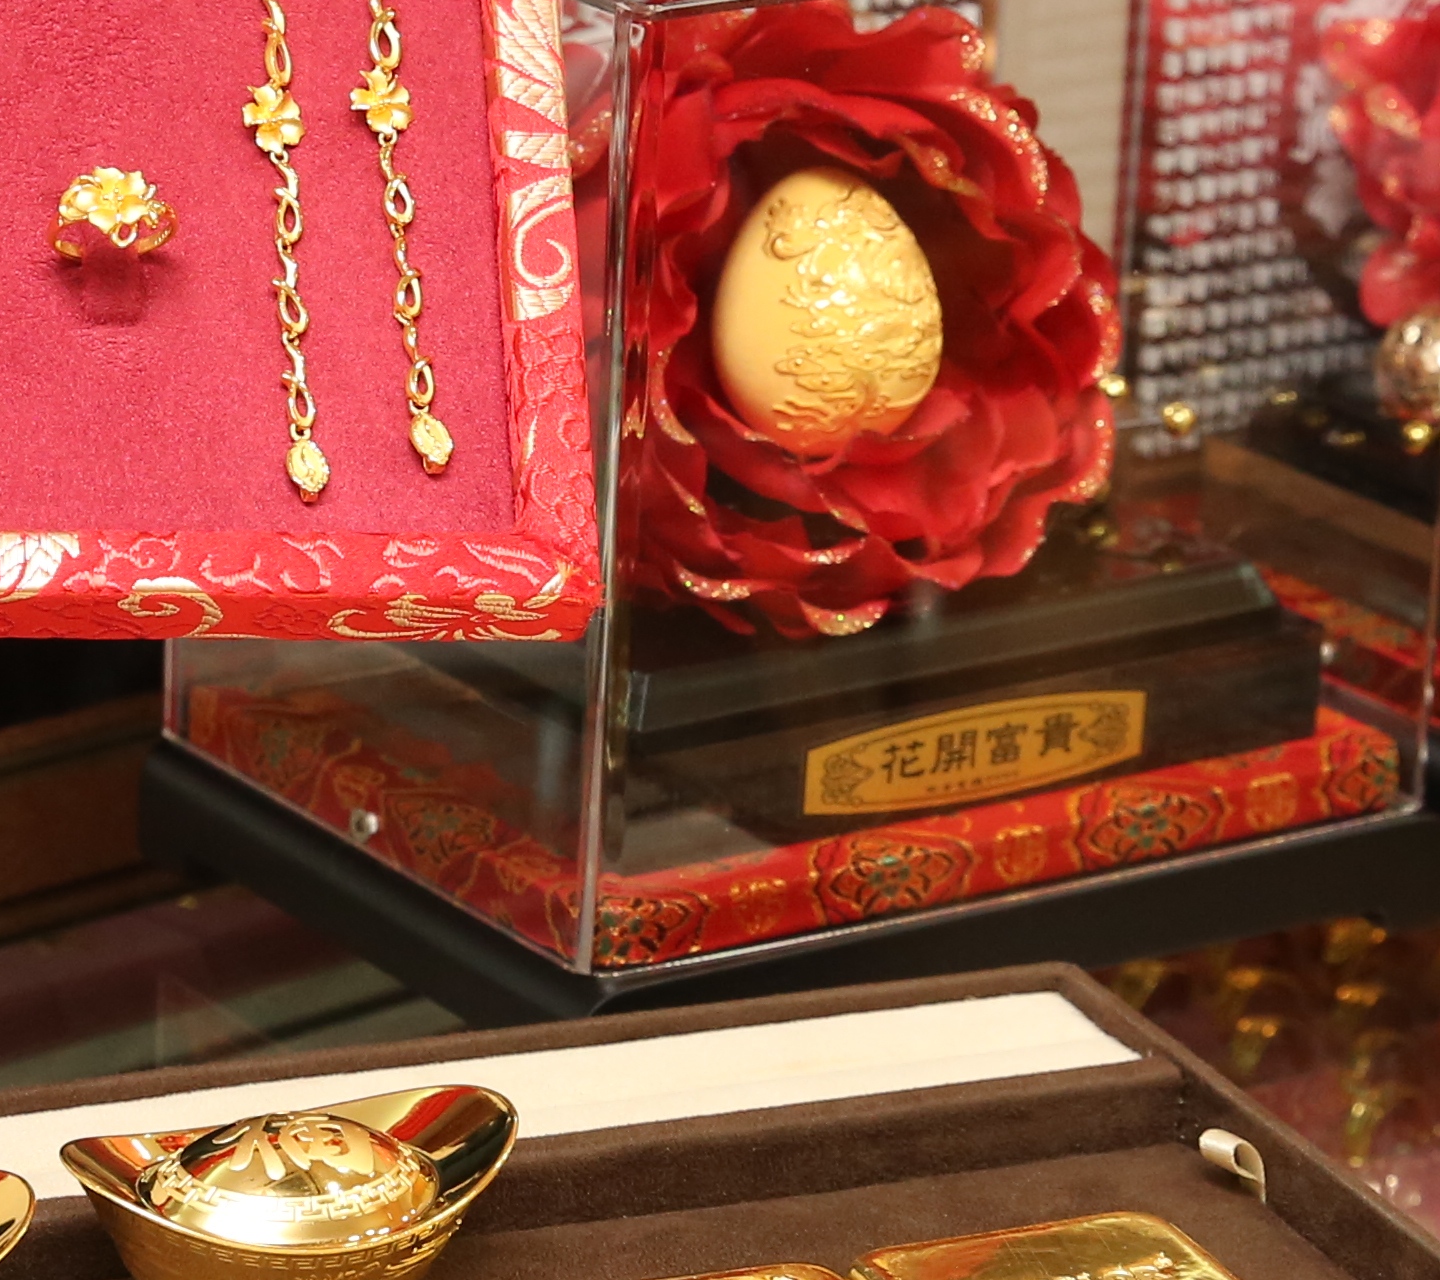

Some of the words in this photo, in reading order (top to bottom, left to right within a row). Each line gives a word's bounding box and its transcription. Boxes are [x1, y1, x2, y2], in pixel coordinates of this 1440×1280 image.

[881, 712, 1078, 784] 花開富貴
[229, 1112, 377, 1181] 福
